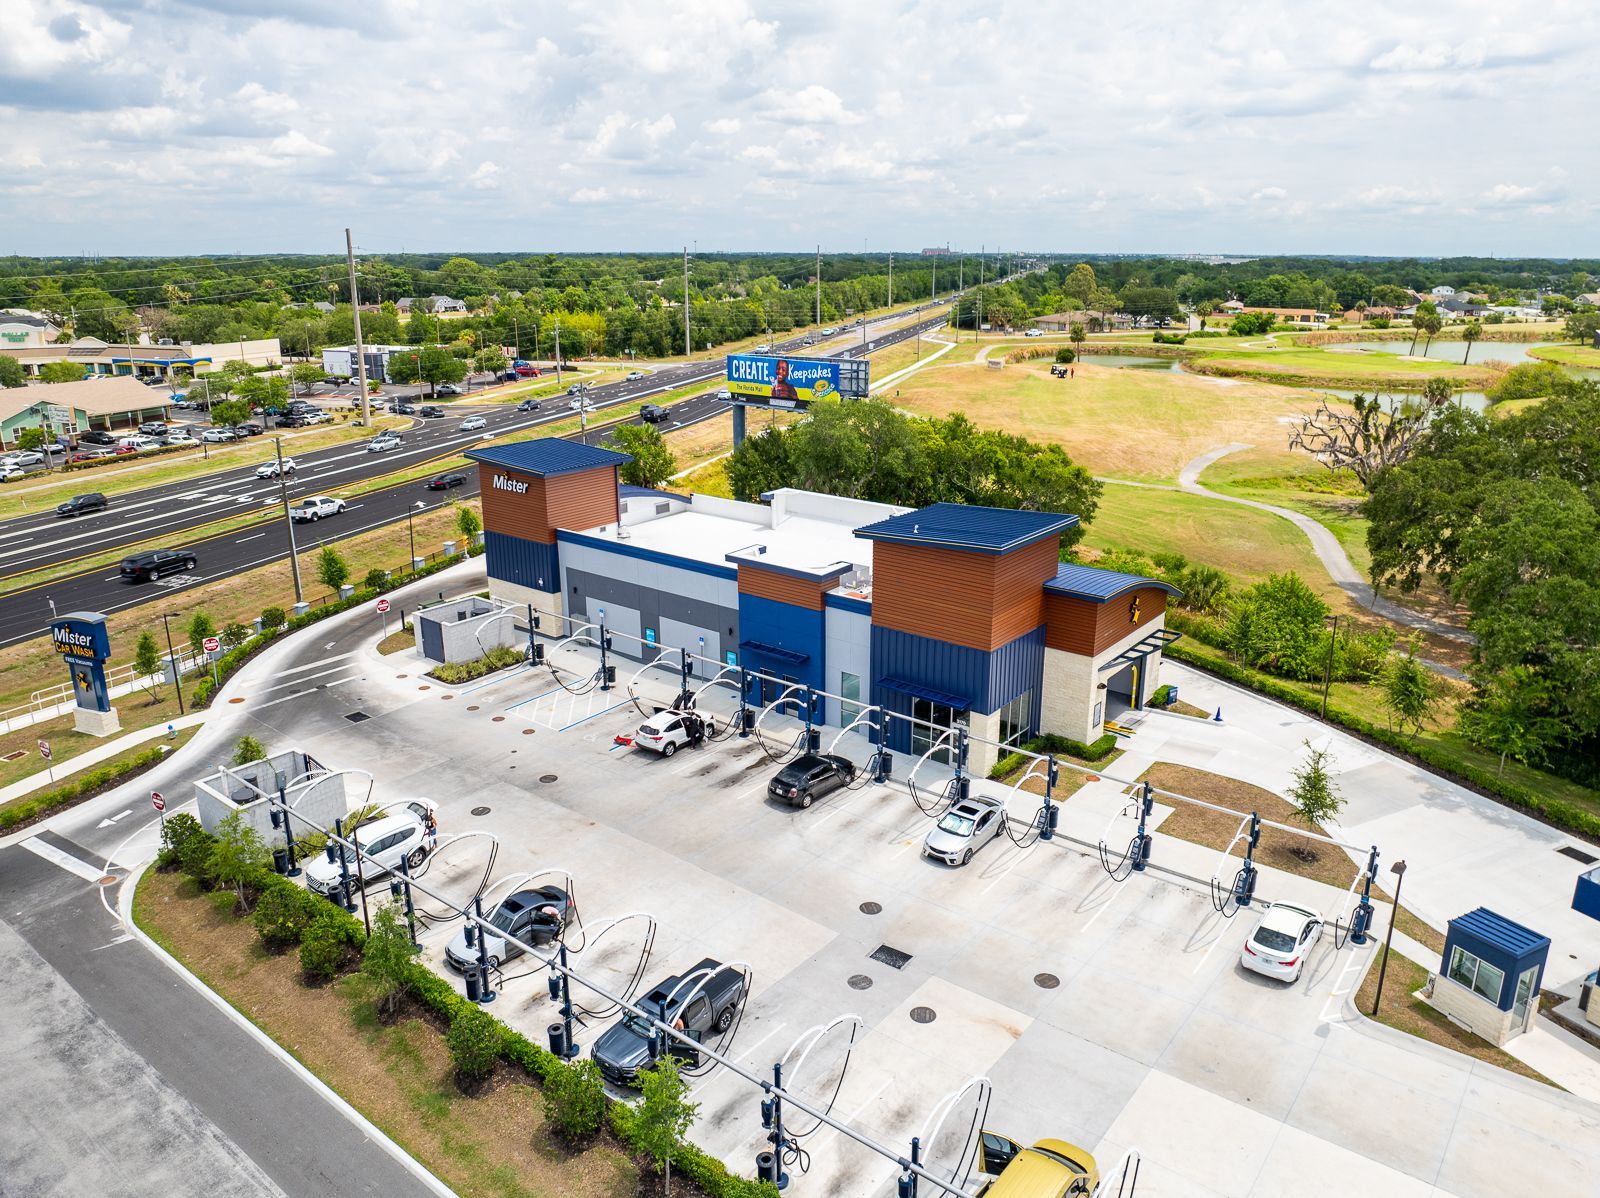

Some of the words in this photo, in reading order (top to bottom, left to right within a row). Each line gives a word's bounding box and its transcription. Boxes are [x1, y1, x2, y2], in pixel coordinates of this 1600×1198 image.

[732, 360, 769, 381] CREATE
[788, 364, 832, 383] Keepsakes
[493, 474, 528, 494] Mister
[54, 627, 92, 646] Mister
[55, 641, 71, 653] CAR
[71, 645, 94, 657] WASH
